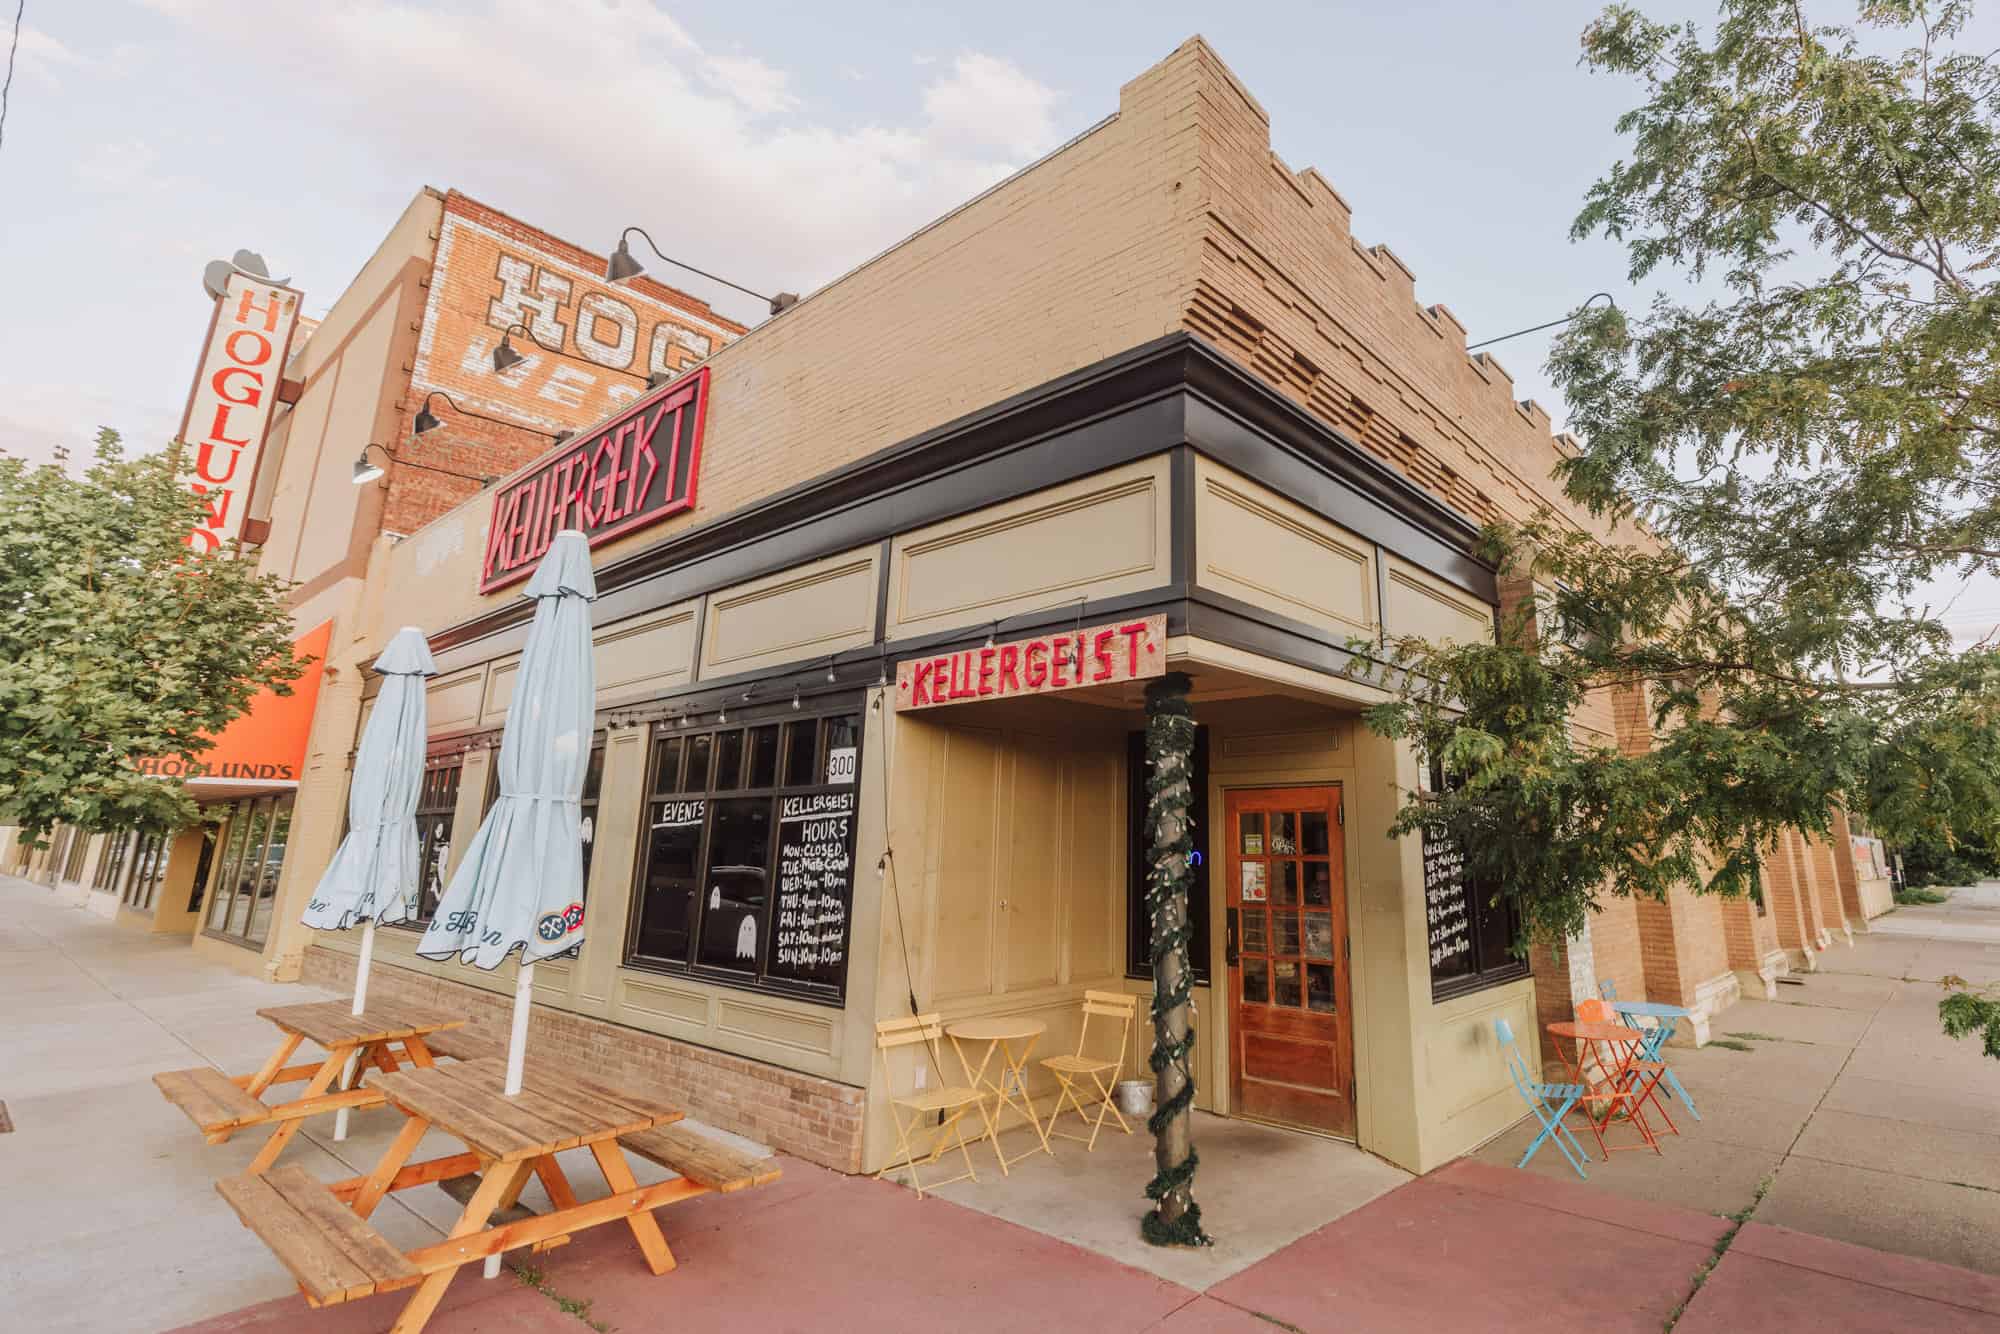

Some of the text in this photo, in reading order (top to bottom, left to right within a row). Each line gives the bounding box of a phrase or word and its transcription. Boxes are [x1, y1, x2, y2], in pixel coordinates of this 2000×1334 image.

[485, 385, 694, 578] KELLERGEIST
[912, 622, 1147, 707] KELLERGEIST
[830, 755, 854, 776] 300
[663, 800, 705, 822] EVENTS
[783, 793, 854, 817] KELLERGEIST
[802, 819, 848, 842] HOURS
[804, 843, 842, 858] CLOSED
